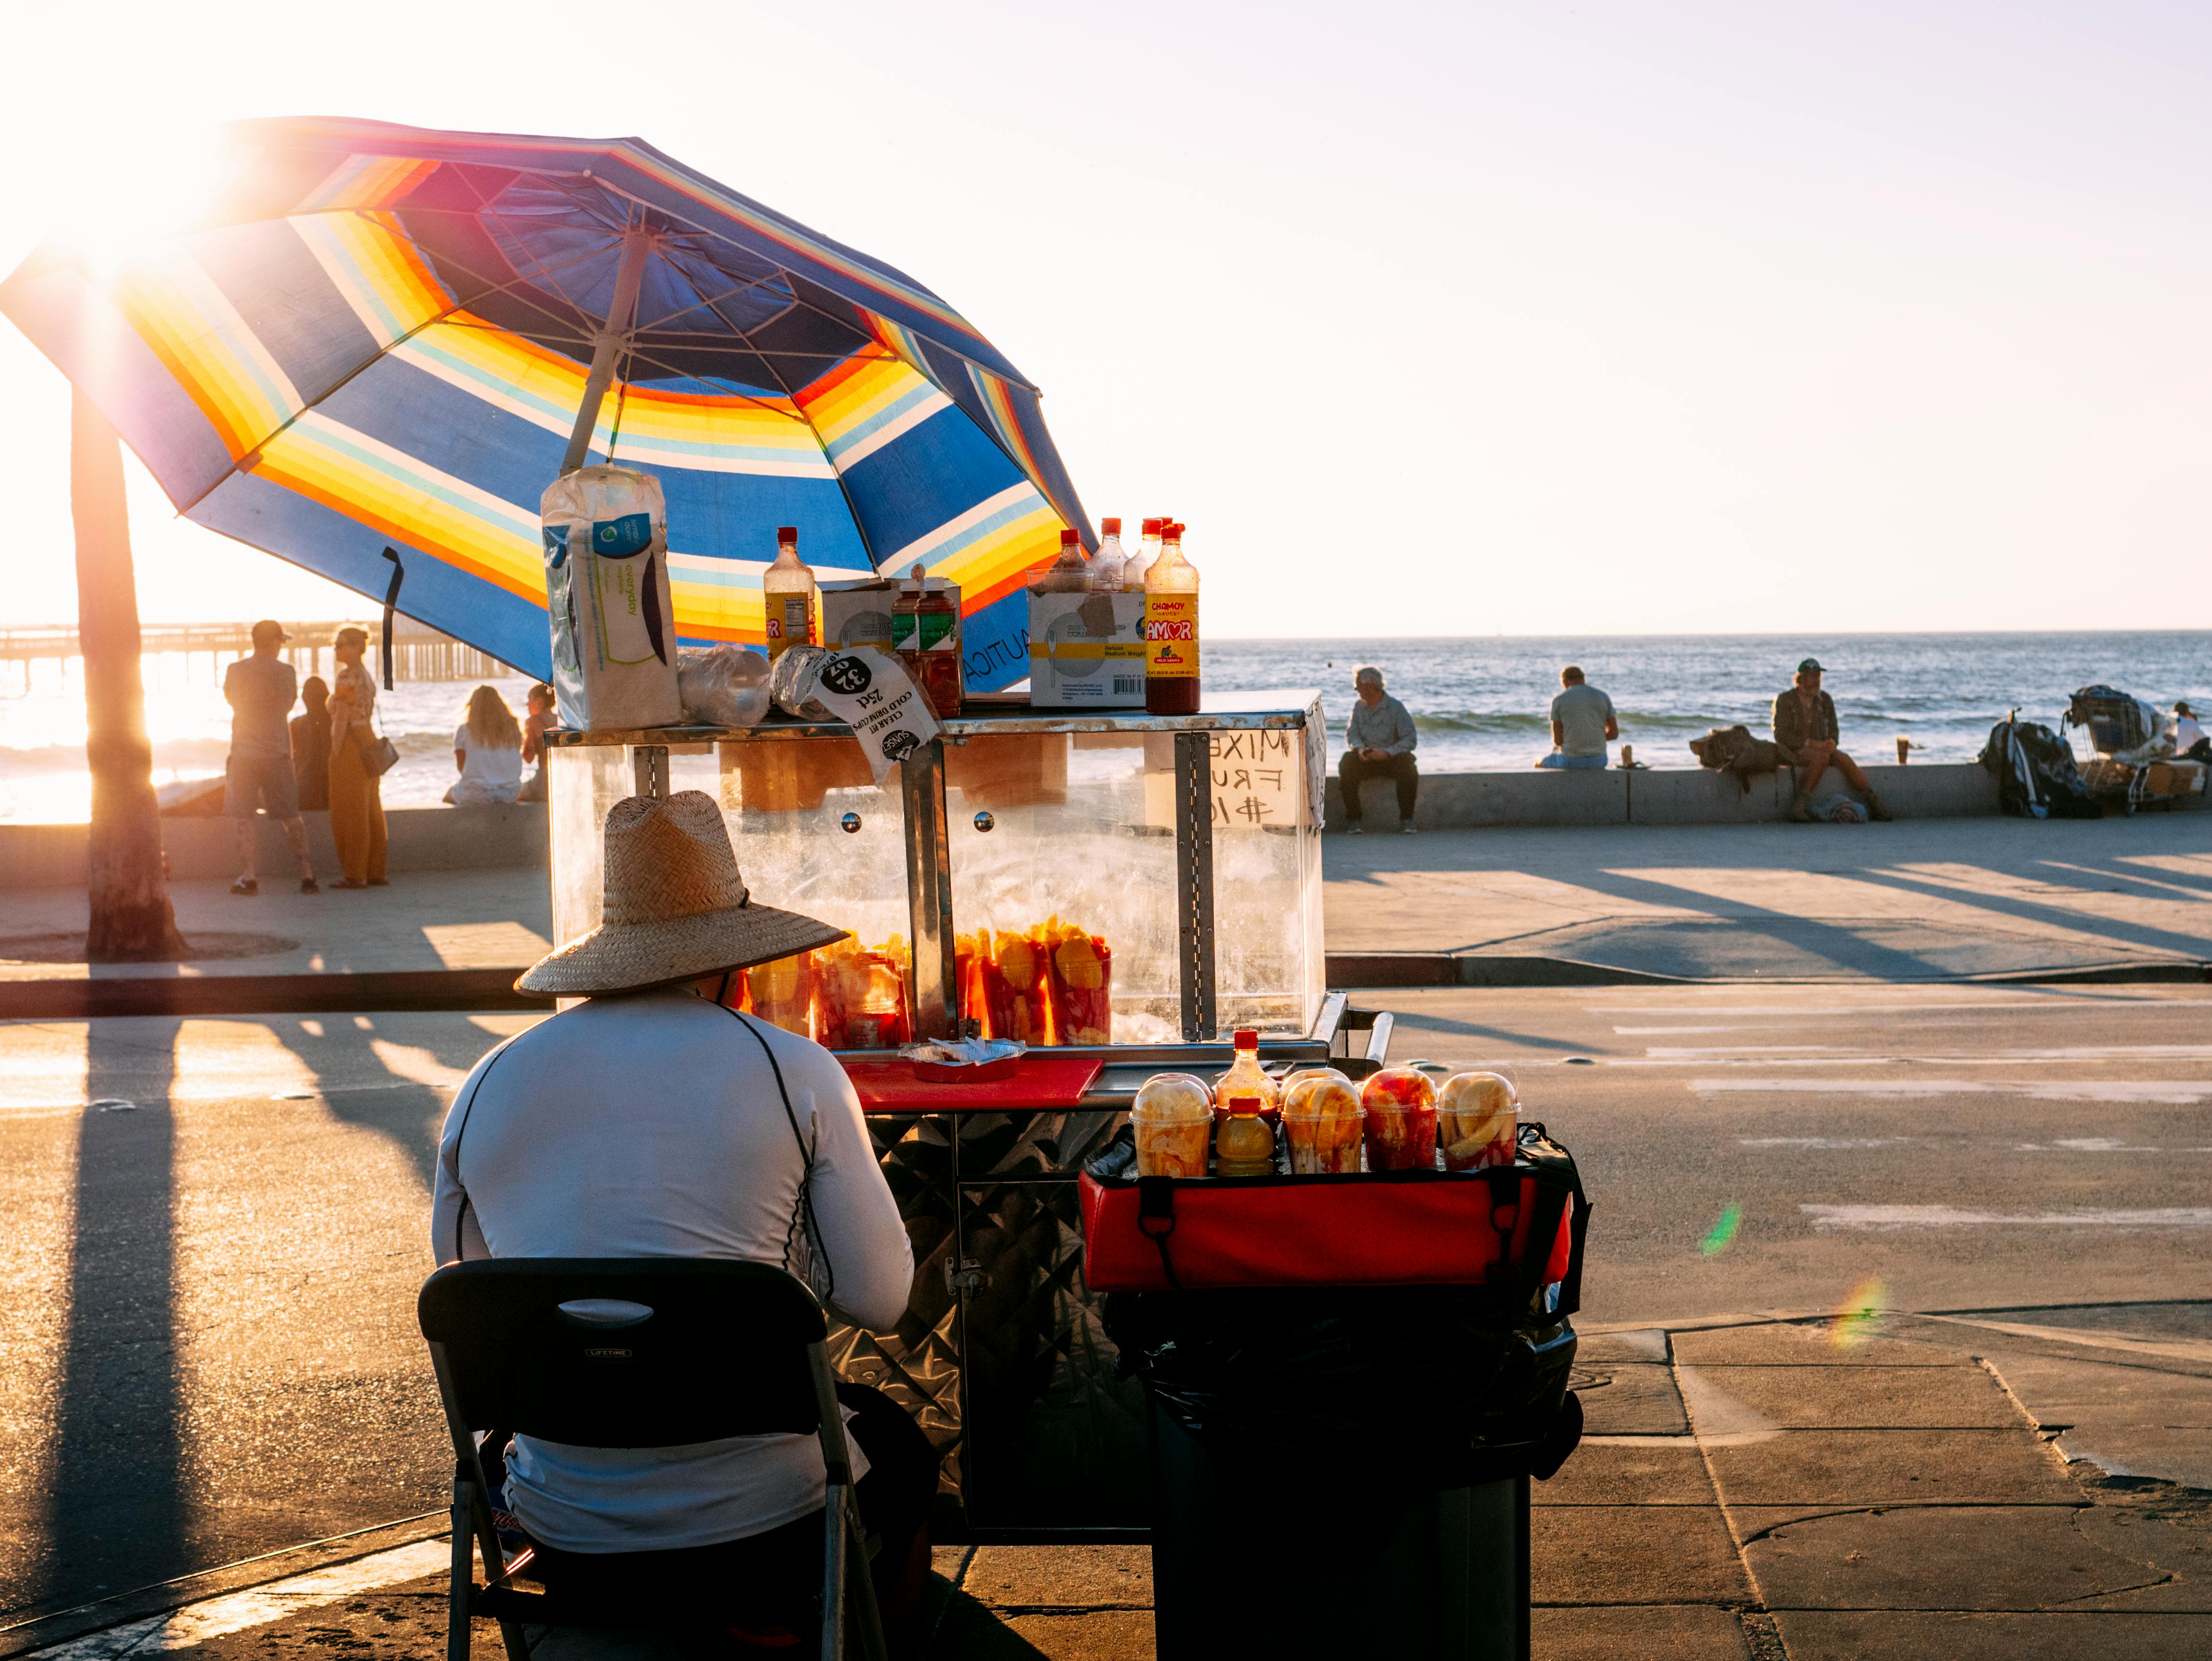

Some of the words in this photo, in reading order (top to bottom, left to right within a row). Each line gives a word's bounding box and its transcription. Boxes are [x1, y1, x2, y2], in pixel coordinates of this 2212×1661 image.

[631, 519, 640, 544] simply
[625, 564, 637, 616] everyday
[1152, 602, 1185, 610] CHAMOY
[836, 668, 865, 691] 32
[855, 688, 883, 710] 25ct
[888, 691, 913, 711] COLD
[868, 706, 887, 721] DRINK
[878, 711, 903, 728] CLEAR
[852, 717, 869, 731] CUPS
[869, 722, 879, 735] PET
[882, 729, 909, 752] SUNSET
